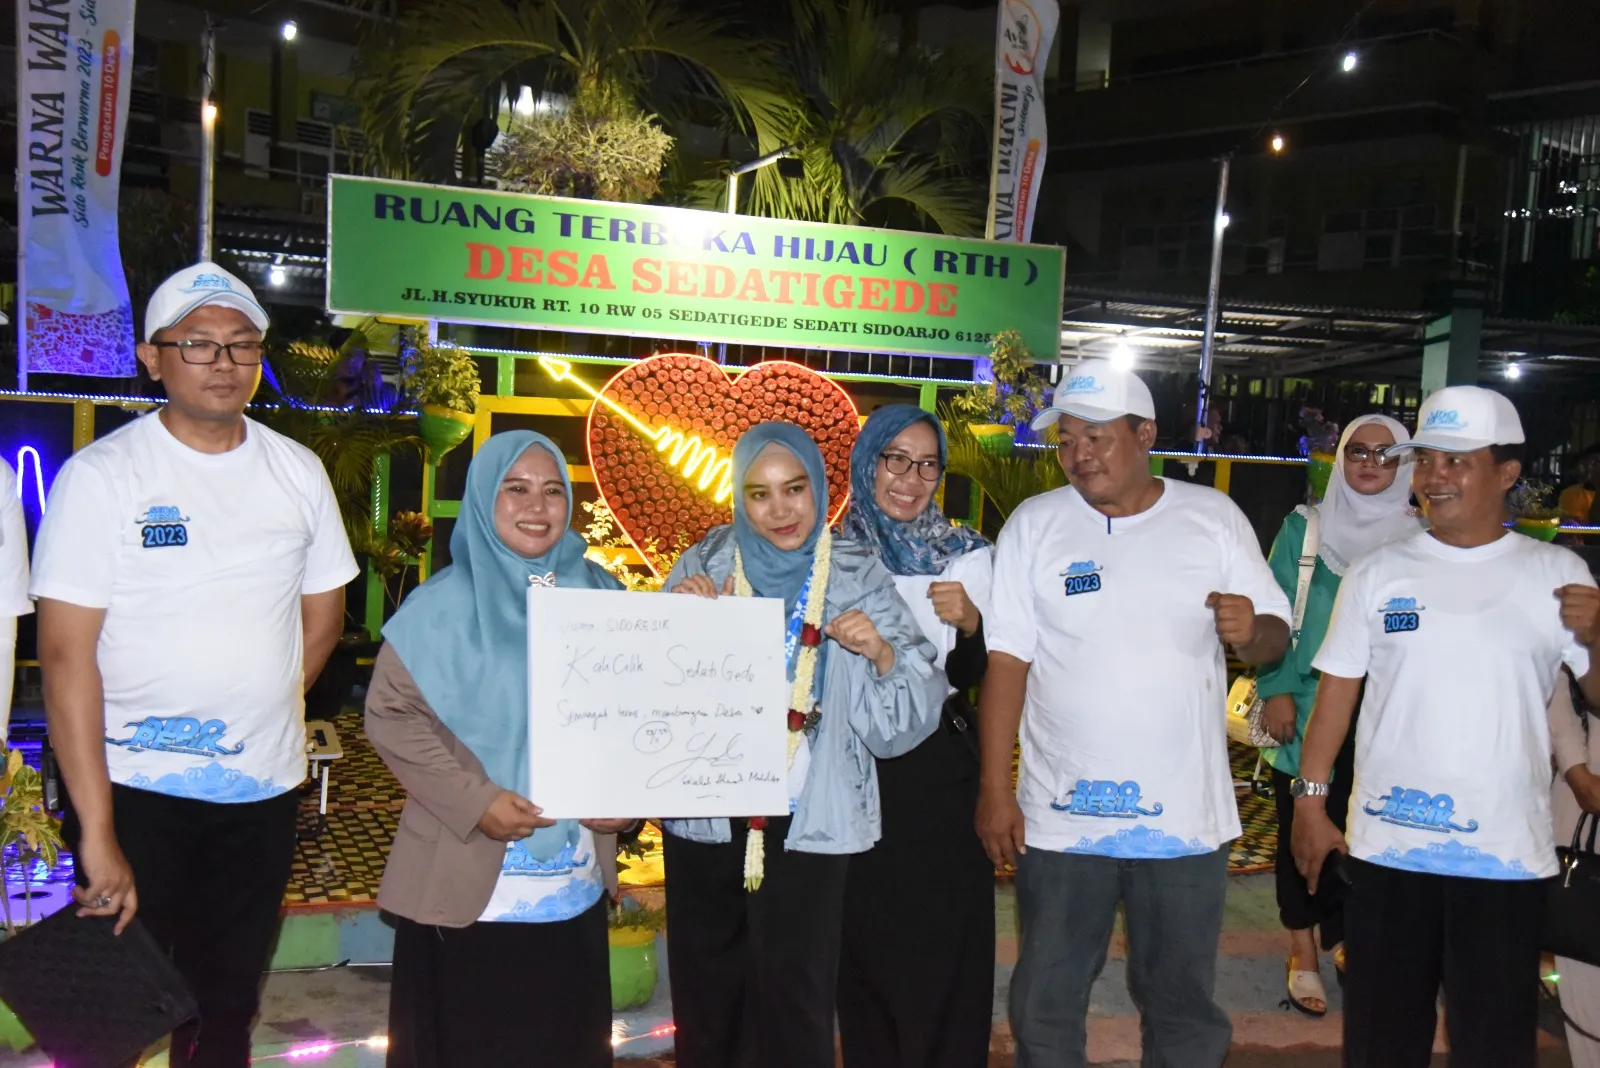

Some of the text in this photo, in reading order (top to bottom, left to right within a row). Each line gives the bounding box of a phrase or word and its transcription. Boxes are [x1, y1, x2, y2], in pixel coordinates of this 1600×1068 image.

[75, 38, 93, 78] 2023
[103, 75, 114, 89] 10
[69, 80, 90, 153] Berwarna
[98, 93, 113, 161] Pengecatan
[31, 91, 69, 218] WARNA
[70, 154, 88, 191] Resik
[72, 194, 89, 228] Sido
[374, 193, 535, 235] RUANG
[553, 212, 757, 256] TERBKA
[773, 235, 888, 267] HIJAU
[934, 250, 1009, 279] RTH
[464, 242, 958, 318] DESA SEDATIGEDE
[401, 286, 993, 344] JL.H.SYUKUR RT. 10 RW 05 SEDATIGEDE SEDATI SIDOARJO 6125
[143, 525, 187, 547] 2023
[1066, 574, 1100, 595] 2023
[1385, 614, 1418, 632] 2023
[1069, 795, 1143, 813] RESIK
[1074, 779, 1141, 798] SIDO
[1381, 801, 1455, 828] RESIK
